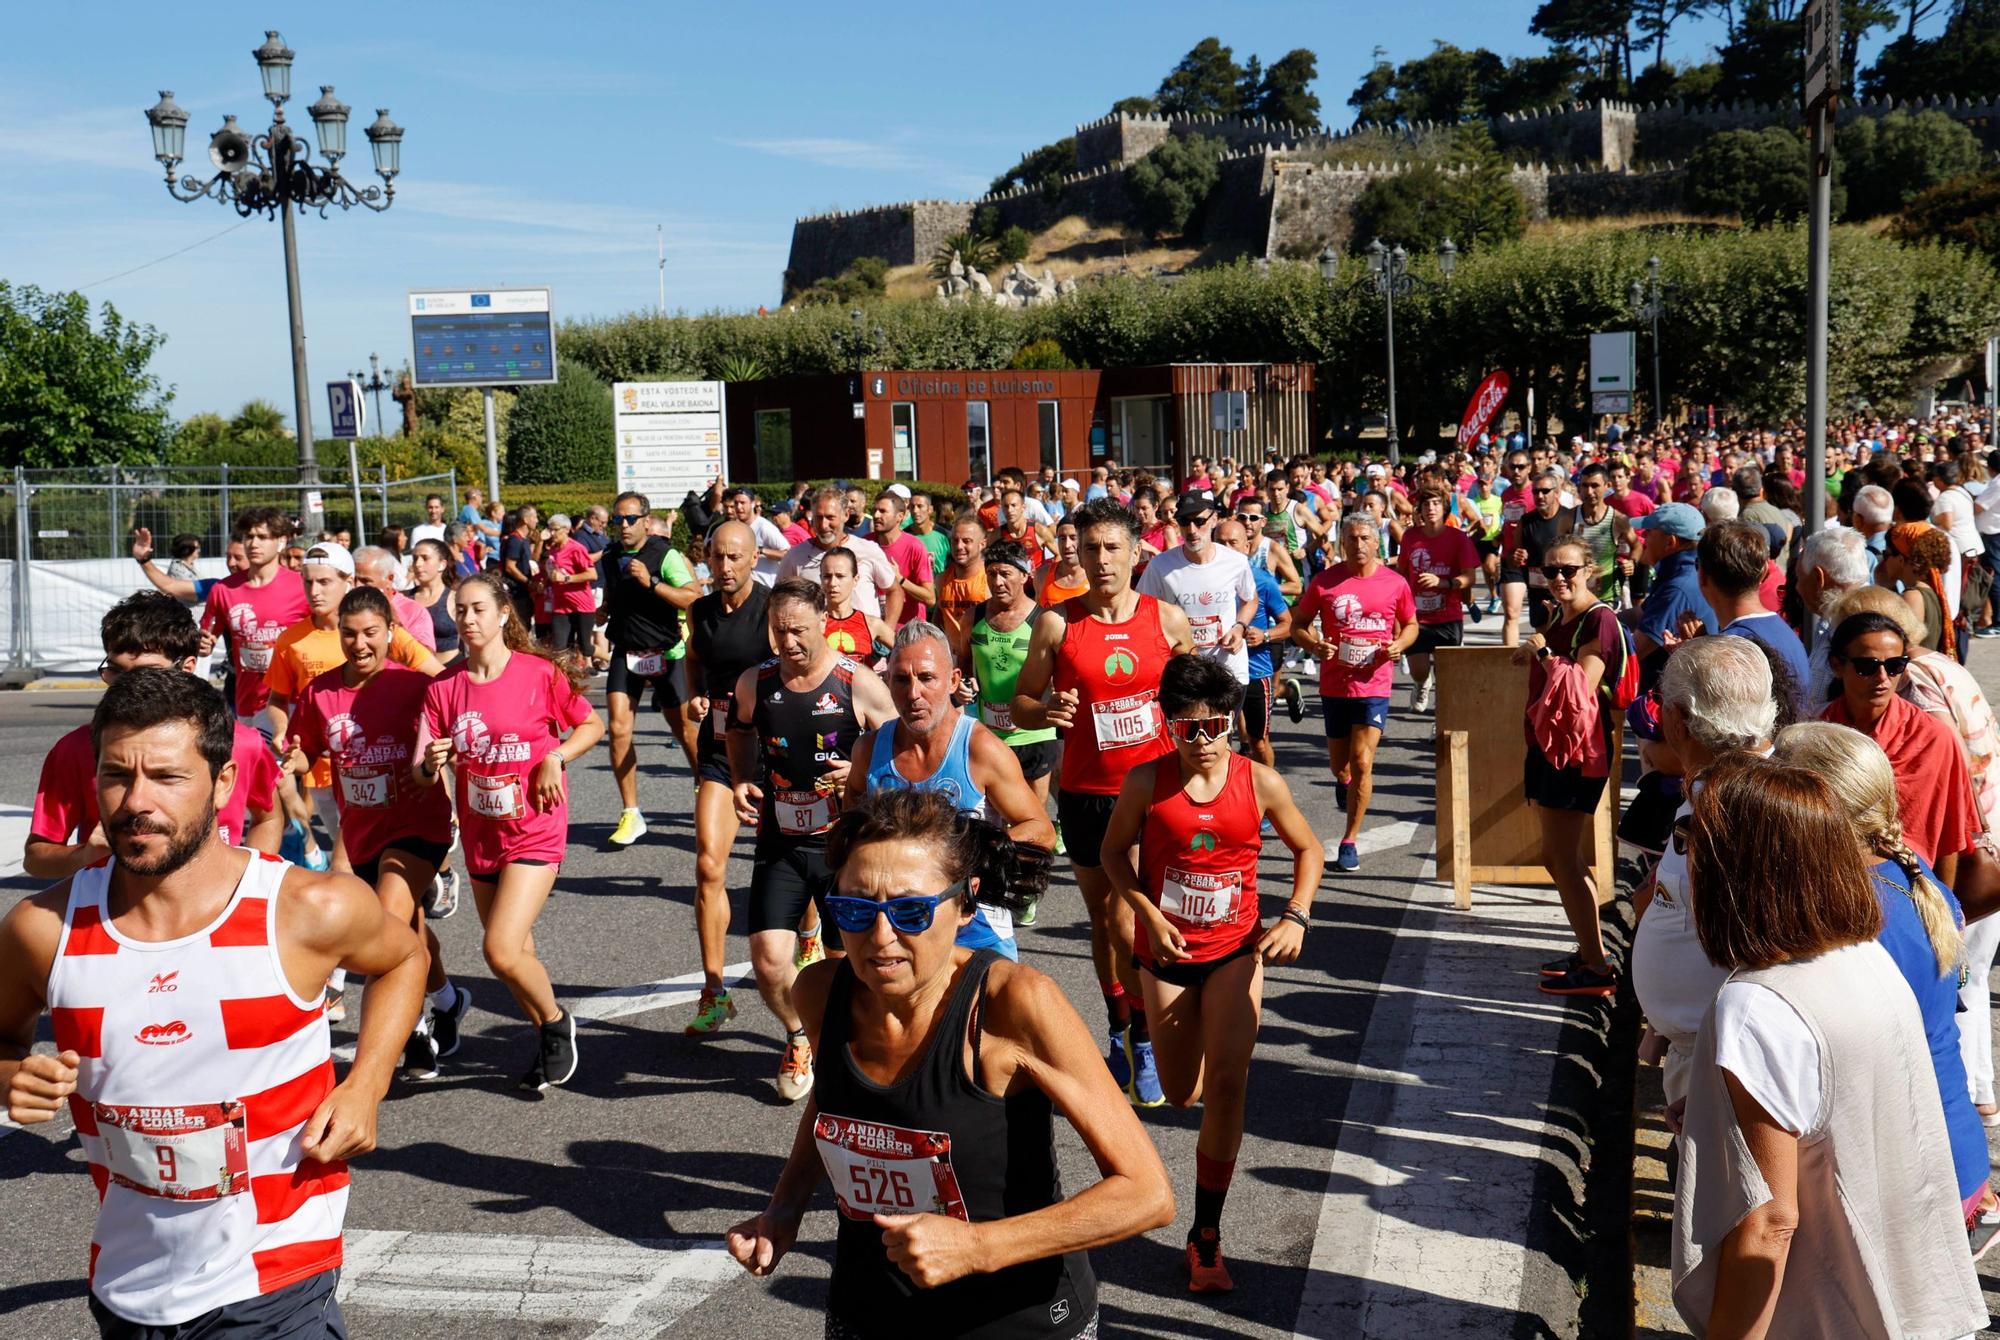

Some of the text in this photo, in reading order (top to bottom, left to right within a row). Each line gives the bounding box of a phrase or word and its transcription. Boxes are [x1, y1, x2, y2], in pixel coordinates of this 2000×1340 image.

[664, 386, 699, 395] VOSTEDE
[898, 378, 961, 394] Oficina
[967, 378, 987, 393] de
[992, 379, 1055, 393] turismo
[330, 387, 346, 427] P
[641, 400, 659, 408] REAL
[660, 400, 675, 408] VILA
[687, 399, 714, 407] BAIONA
[341, 415, 355, 426] BUS
[1215, 591, 1229, 603] 22
[637, 660, 655, 672] 1146
[1110, 697, 1136, 707] ANDAR
[1113, 714, 1144, 738] 1105
[490, 742, 531, 756] ANDAR
[814, 751, 840, 761] GIA
[351, 783, 376, 801] 342
[477, 792, 503, 812] 344
[795, 809, 813, 828] 87
[1184, 874, 1216, 882] ANDAR
[1181, 893, 1217, 917] 1104
[148, 984, 178, 993] ZICO
[128, 1108, 186, 1119] ANDAR
[141, 1115, 206, 1128] CORRER
[847, 1122, 896, 1141] ANDAR
[857, 1135, 913, 1154] CORRER
[155, 1145, 177, 1182] 9
[849, 1164, 915, 1208] 526
